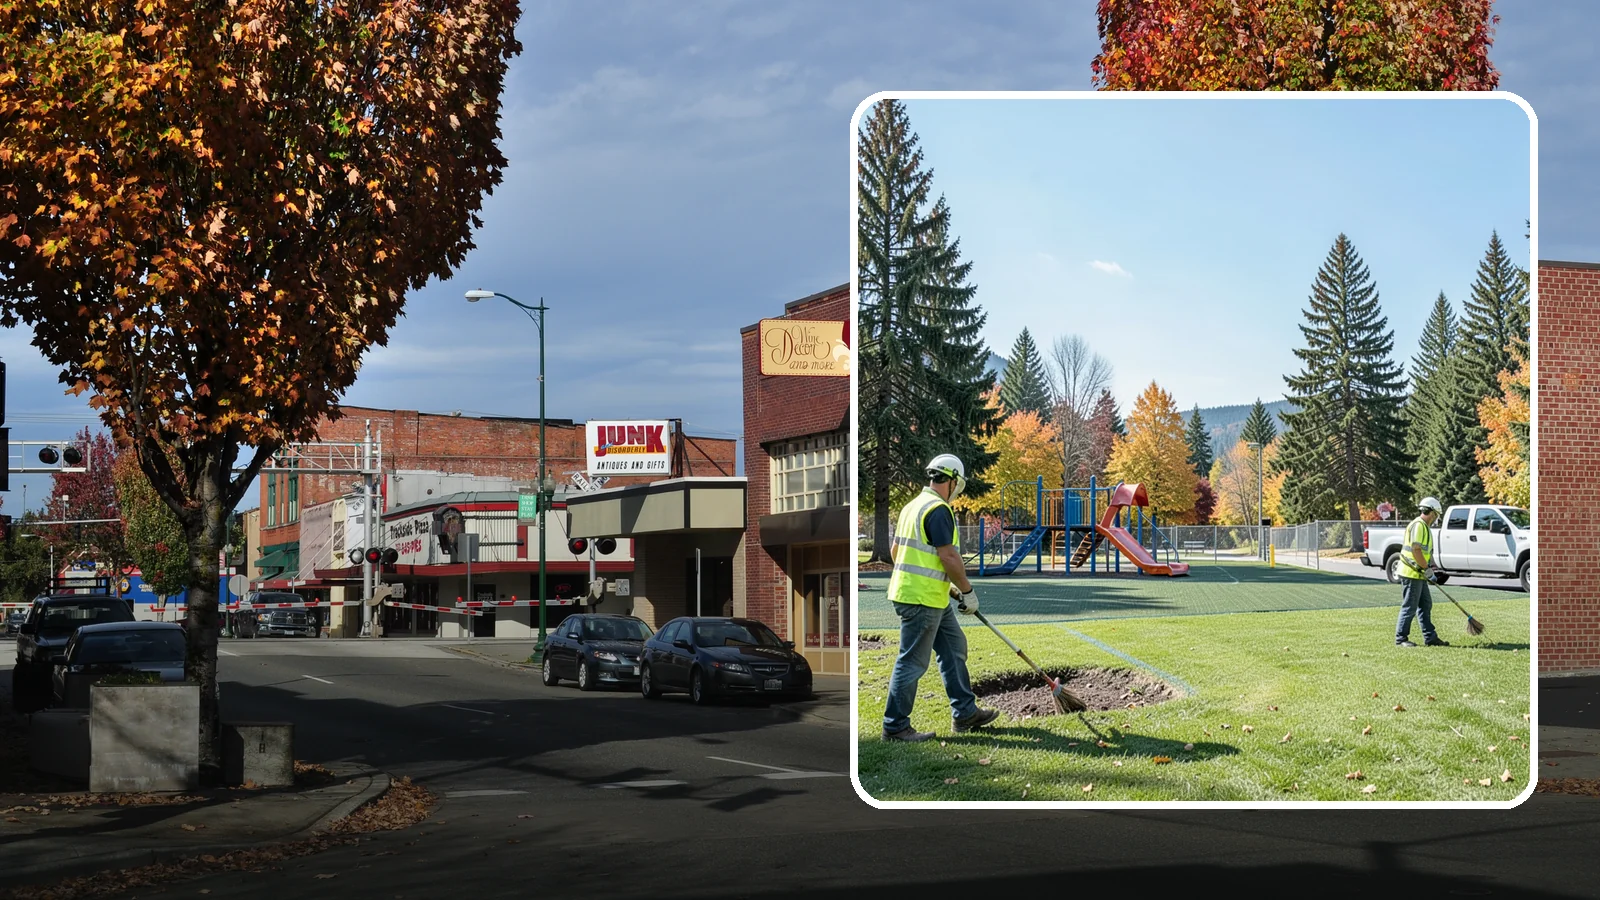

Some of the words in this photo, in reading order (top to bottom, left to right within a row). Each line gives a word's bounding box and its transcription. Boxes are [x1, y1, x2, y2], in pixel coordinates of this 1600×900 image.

[595, 425, 665, 457] JUNK
[607, 446, 646, 454] DISORDERLY
[597, 461, 628, 470] ANTIQUES
[631, 460, 644, 470] AND
[647, 460, 665, 470] GIFTS
[414, 519, 429, 536] Pizza
